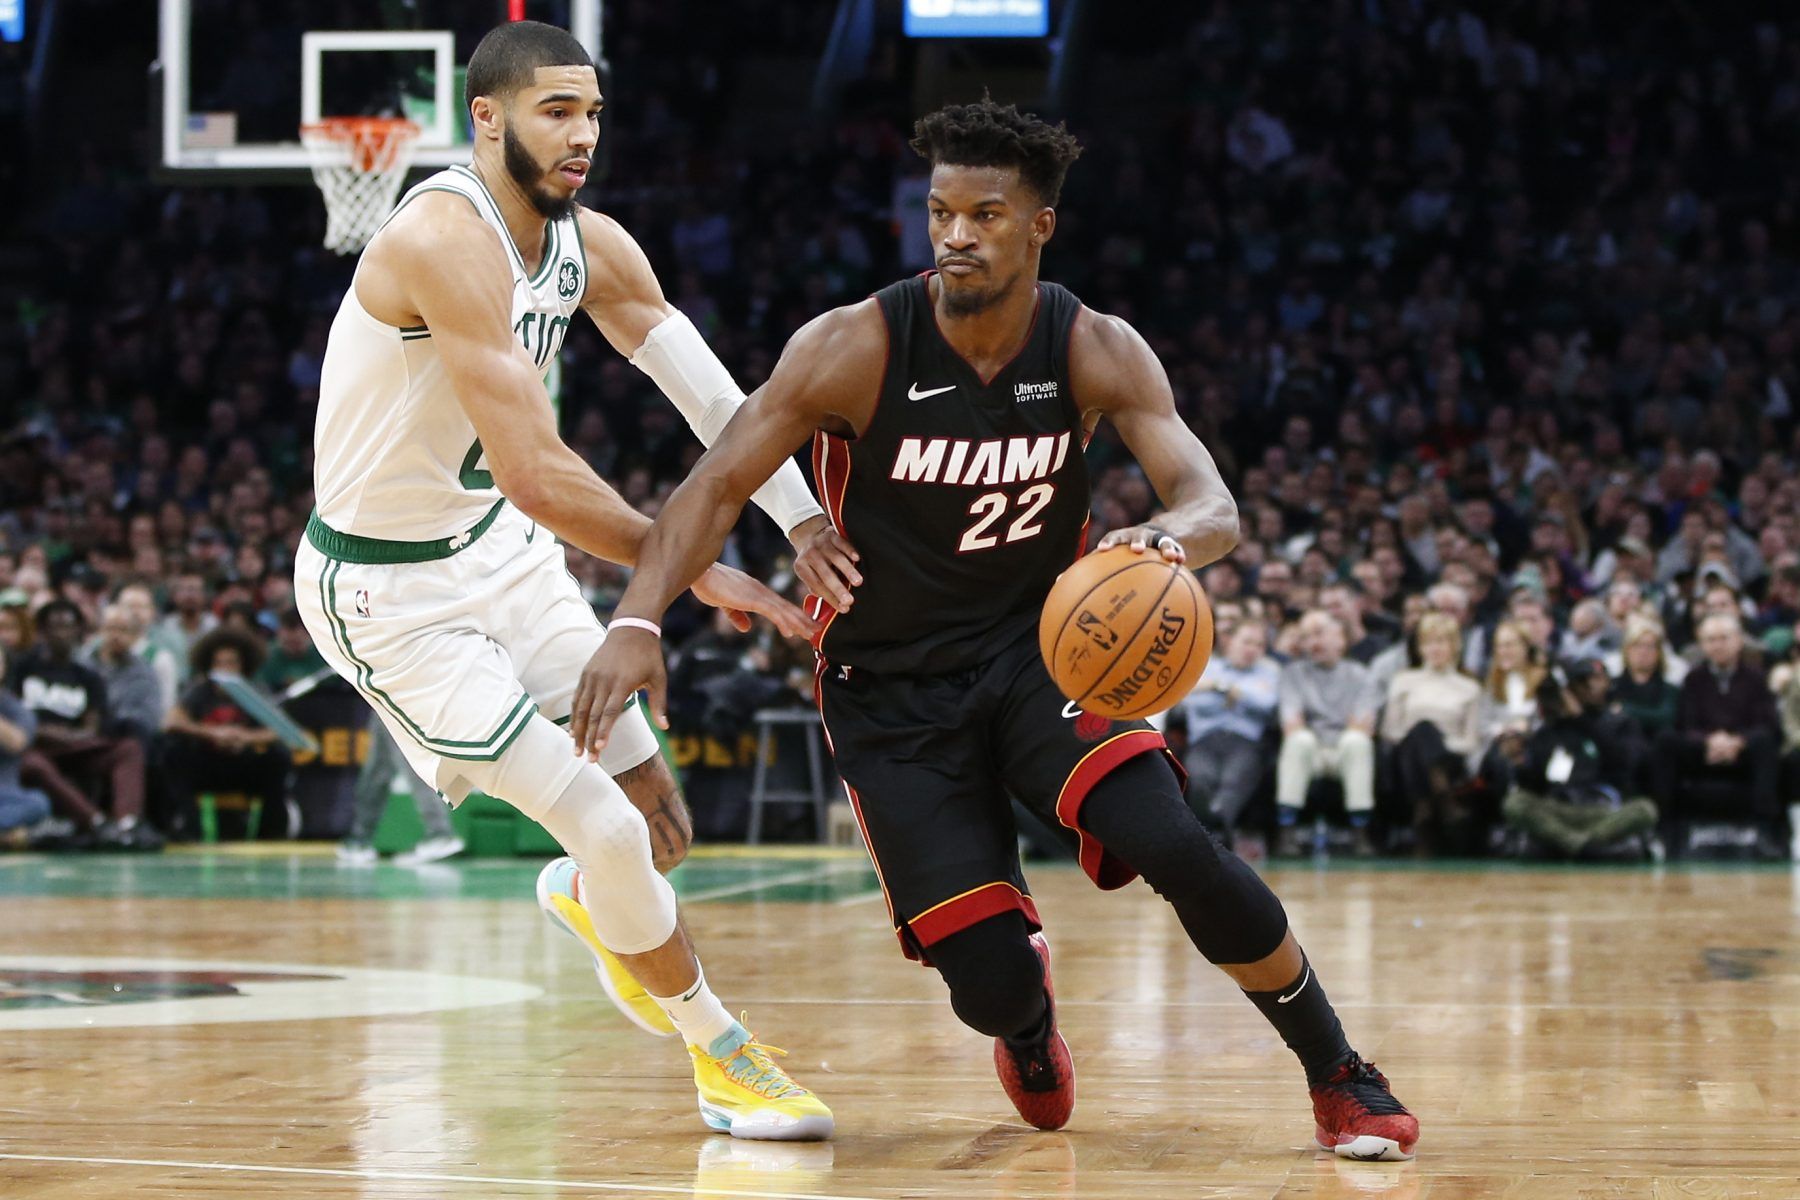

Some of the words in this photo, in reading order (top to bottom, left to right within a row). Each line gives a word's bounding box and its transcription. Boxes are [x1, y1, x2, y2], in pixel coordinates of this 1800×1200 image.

[1014, 381, 1058, 396] Ultimate
[1016, 391, 1058, 403] SOFTWARE
[891, 432, 1071, 486] MIAMI
[958, 483, 1055, 552] 22
[1093, 606, 1186, 711] SPALDING
